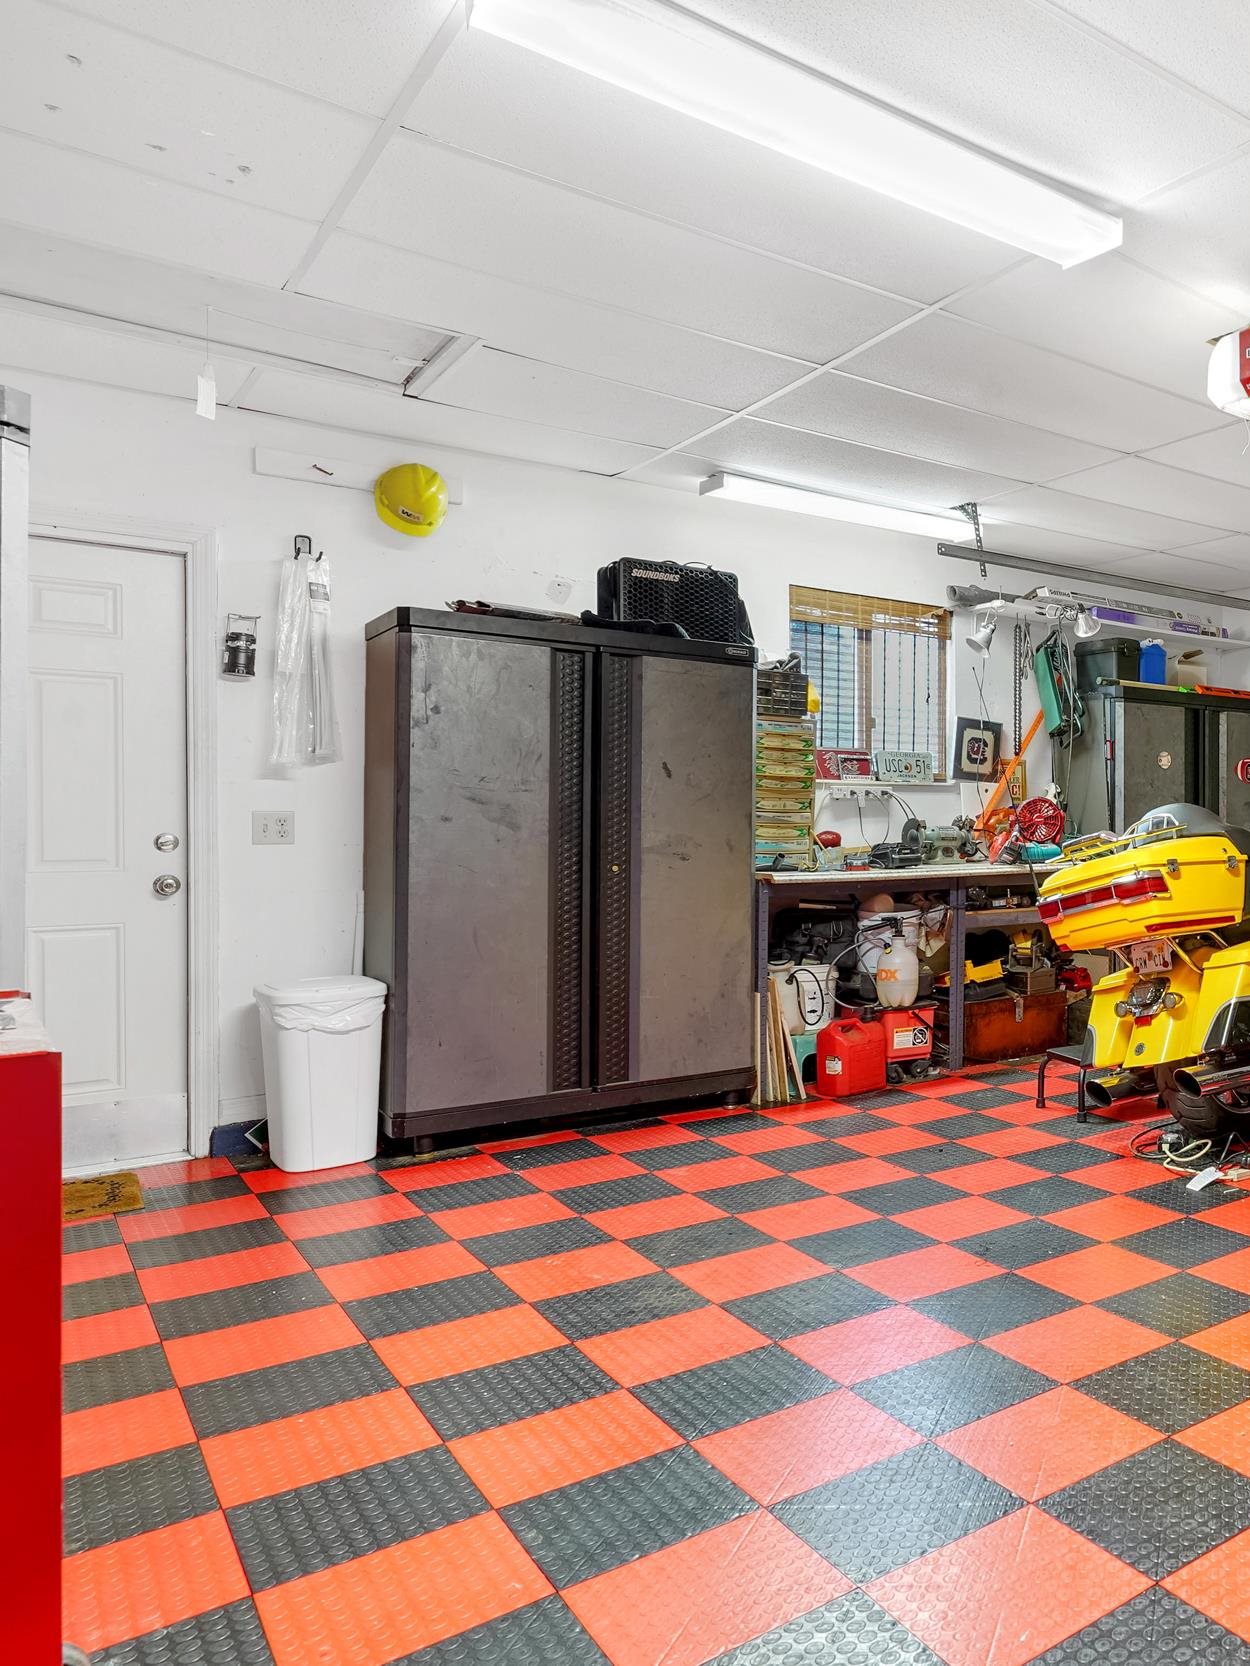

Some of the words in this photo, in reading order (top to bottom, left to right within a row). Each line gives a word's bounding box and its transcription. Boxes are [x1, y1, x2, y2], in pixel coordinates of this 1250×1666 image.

[631, 568, 680, 582] SOUNDBOKS
[890, 751, 921, 759] GEORGIA
[884, 758, 903, 773] USC
[877, 968, 897, 981] DX
